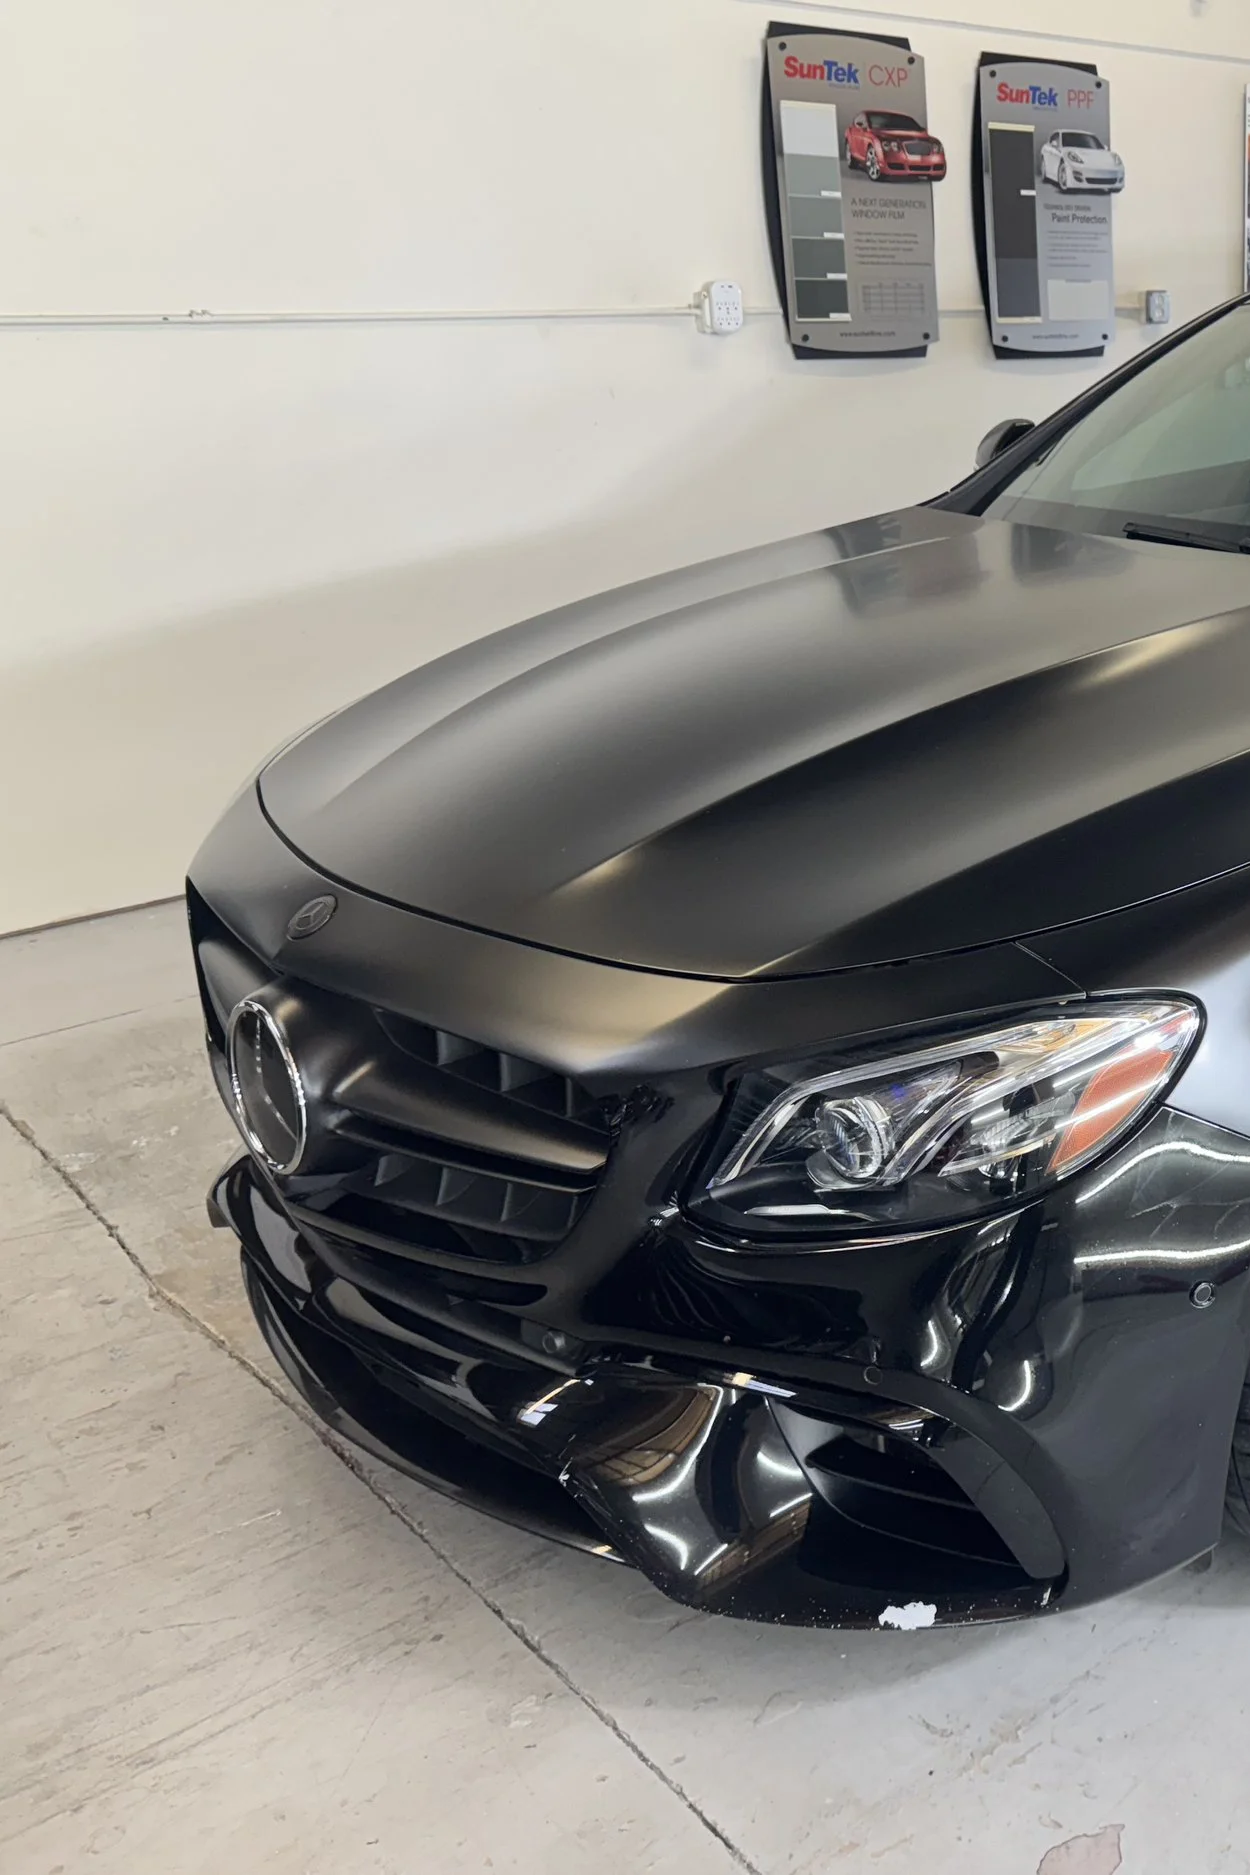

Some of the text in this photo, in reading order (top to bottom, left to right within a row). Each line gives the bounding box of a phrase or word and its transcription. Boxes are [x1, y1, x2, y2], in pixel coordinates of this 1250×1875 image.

[784, 55, 908, 88] SunTek CXP
[996, 82, 1094, 110] SunTek PPF
